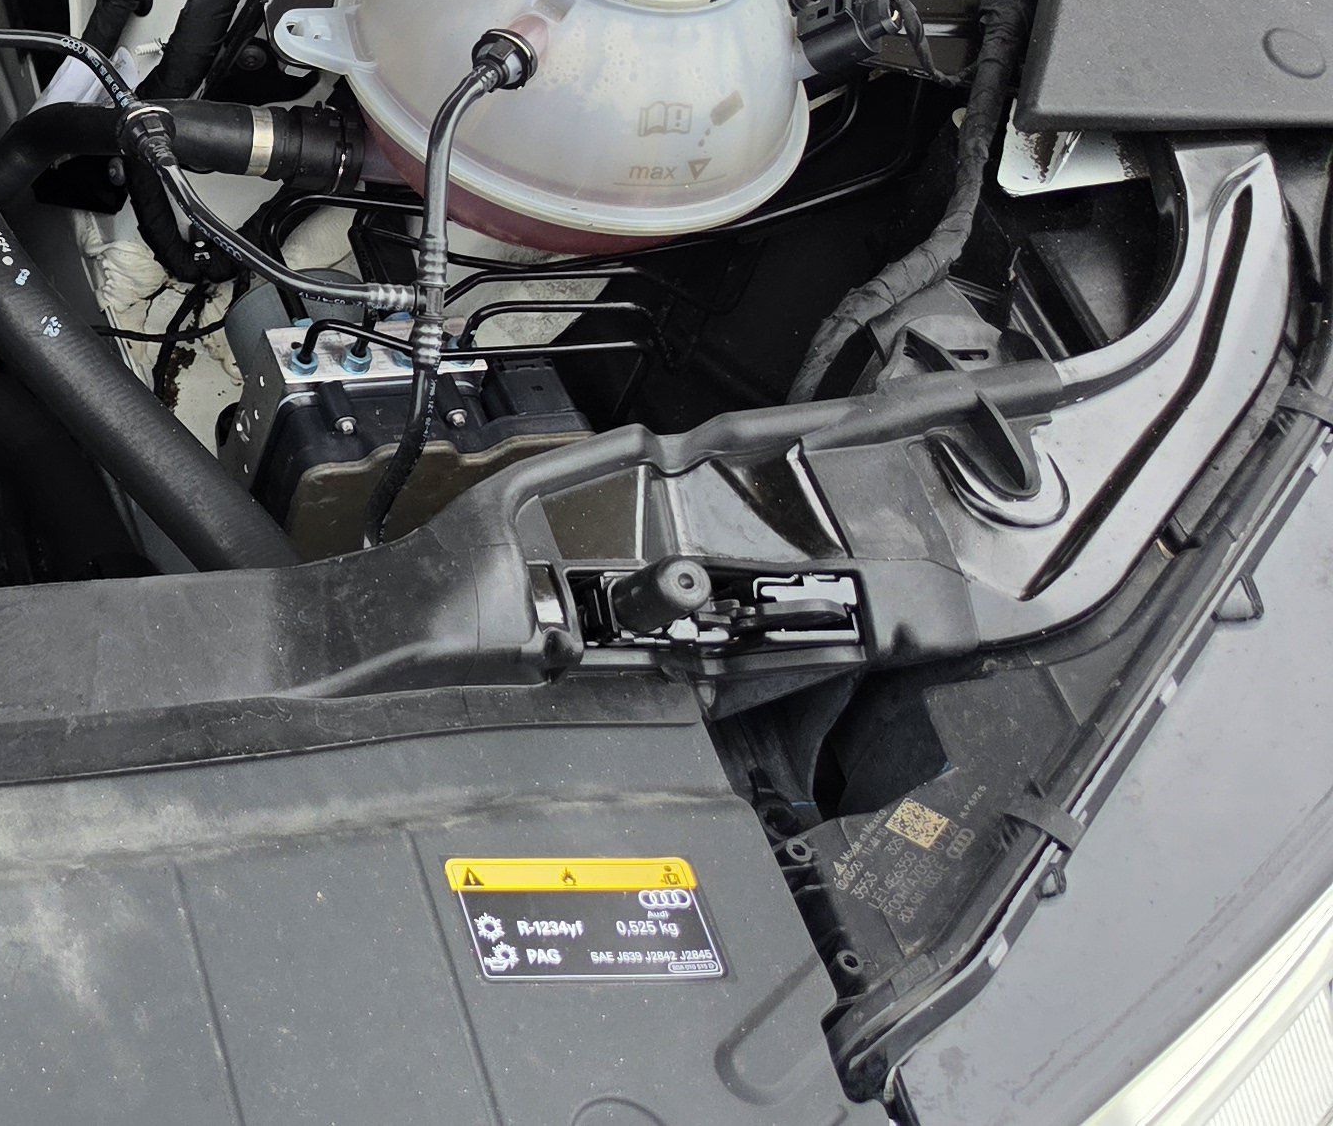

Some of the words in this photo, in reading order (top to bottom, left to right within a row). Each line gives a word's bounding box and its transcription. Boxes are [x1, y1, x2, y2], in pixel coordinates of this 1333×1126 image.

[629, 163, 676, 180] max
[647, 911, 668, 919] Audi
[517, 920, 583, 938] R-1234yf
[616, 921, 655, 937] 0,525
[658, 921, 678, 936] kg
[526, 949, 560, 963] PAG
[590, 951, 612, 963] SAE
[617, 952, 641, 962] J639
[645, 951, 676, 962] J2842
[680, 949, 711, 961] J2845
